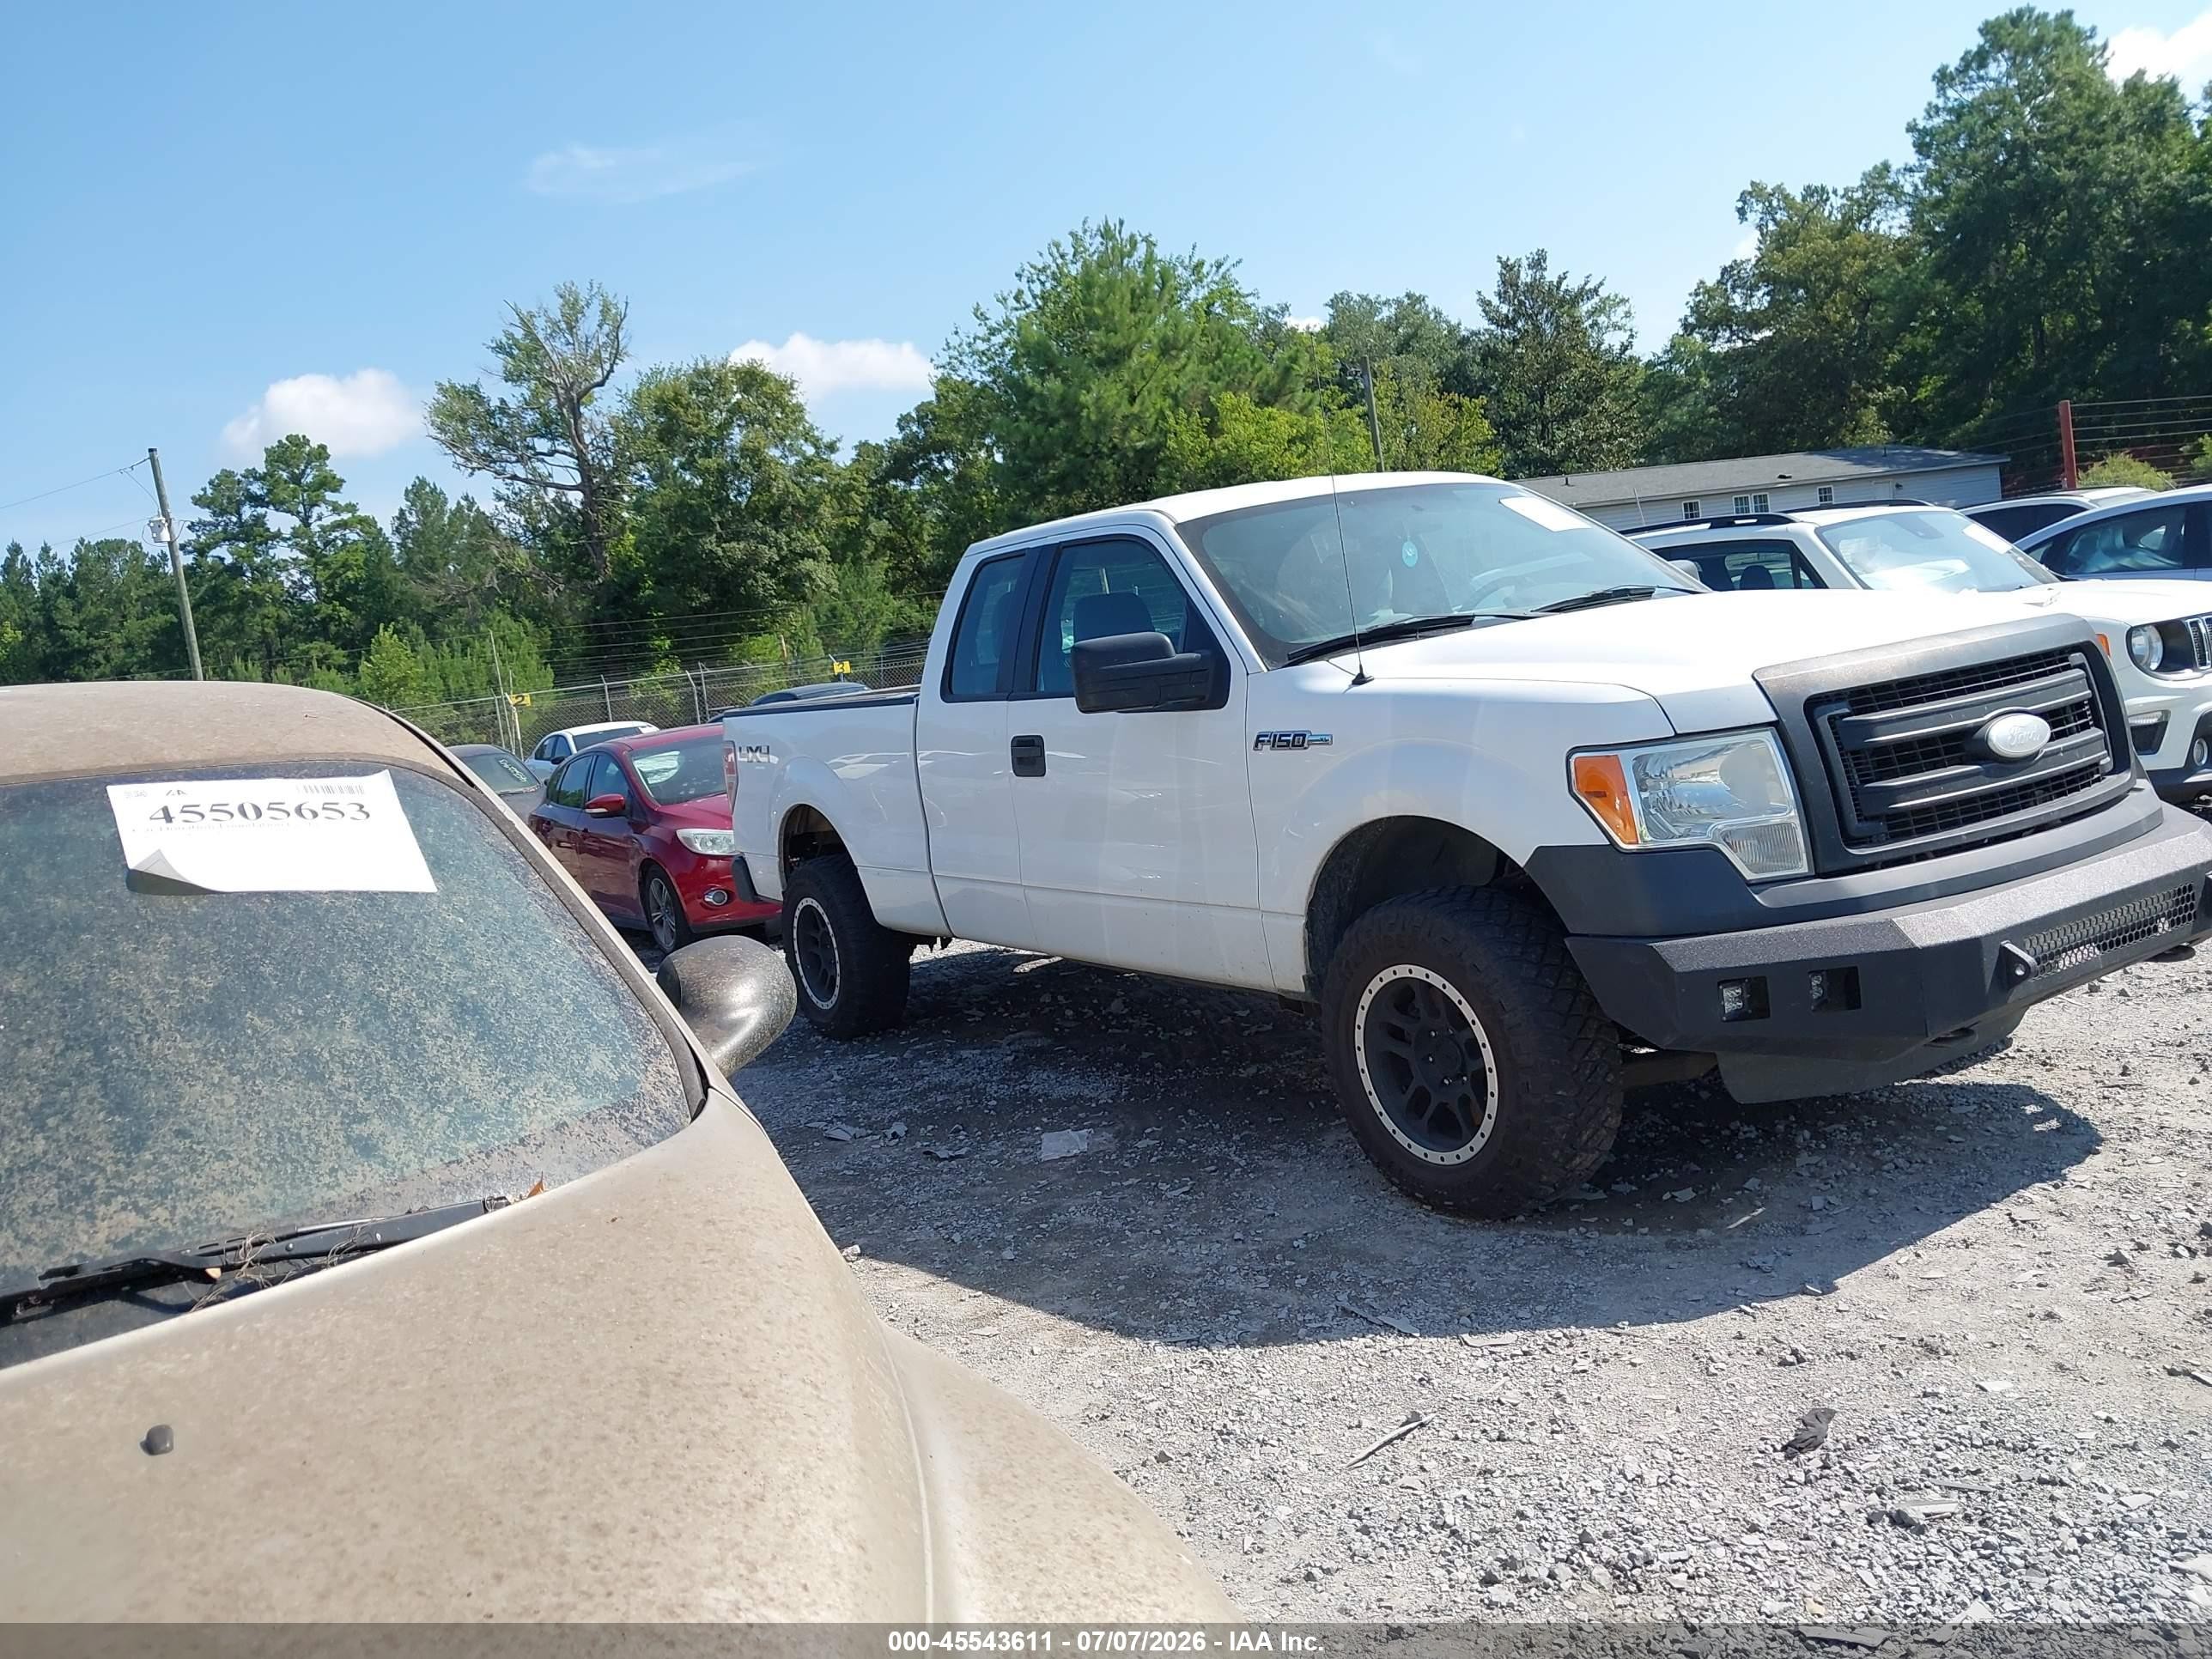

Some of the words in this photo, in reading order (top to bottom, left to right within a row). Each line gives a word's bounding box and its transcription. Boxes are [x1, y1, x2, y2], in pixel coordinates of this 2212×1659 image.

[837, 662, 845, 673] 3
[513, 695, 526, 707] 2
[149, 801, 370, 824] 45505653
